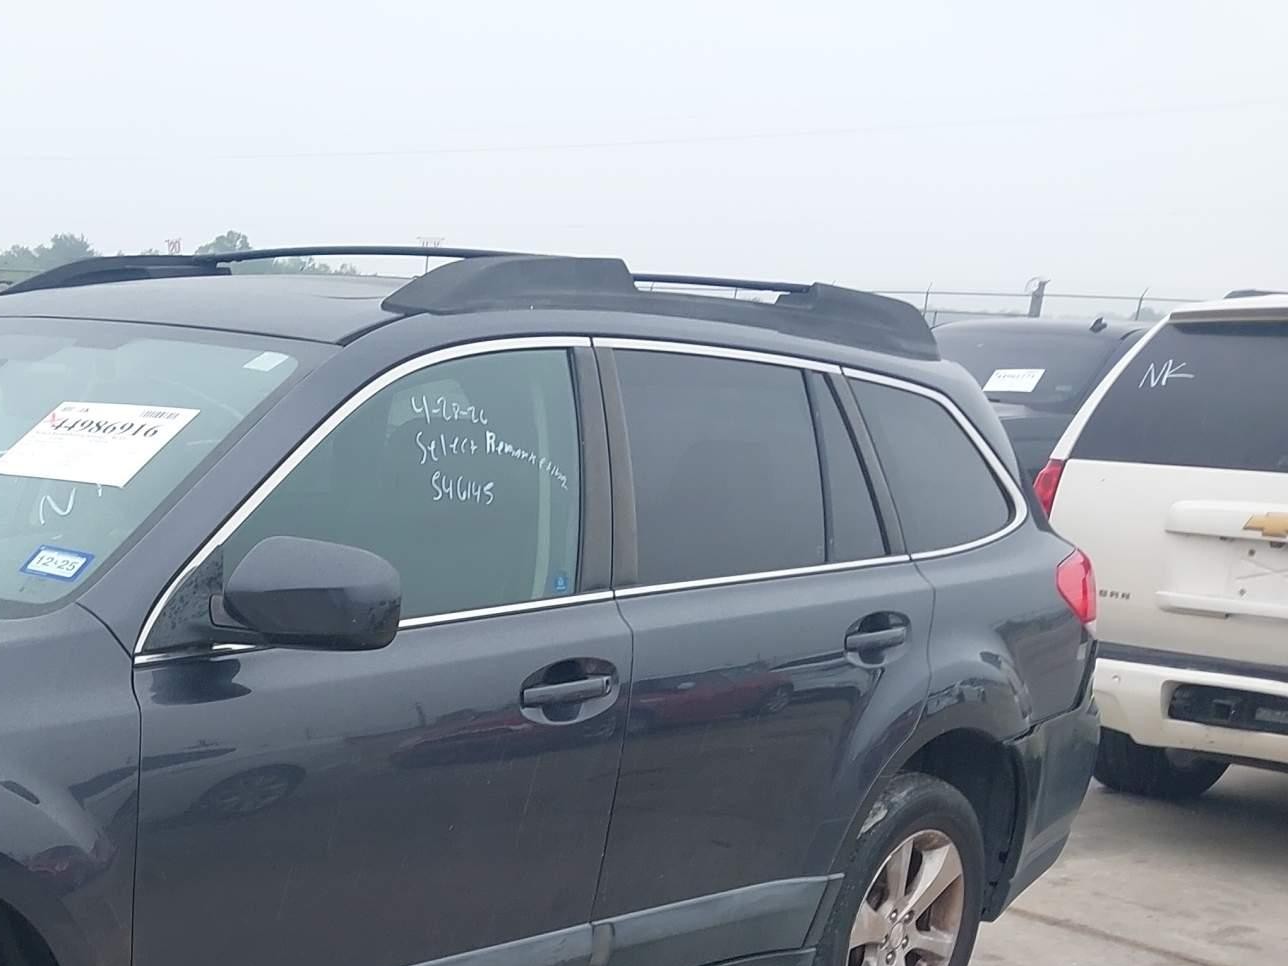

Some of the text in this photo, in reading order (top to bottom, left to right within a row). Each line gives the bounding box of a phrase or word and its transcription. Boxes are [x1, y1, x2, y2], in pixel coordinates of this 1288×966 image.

[1138, 359, 1195, 389] NK
[51, 417, 161, 438] 44986916
[416, 431, 478, 464] Select
